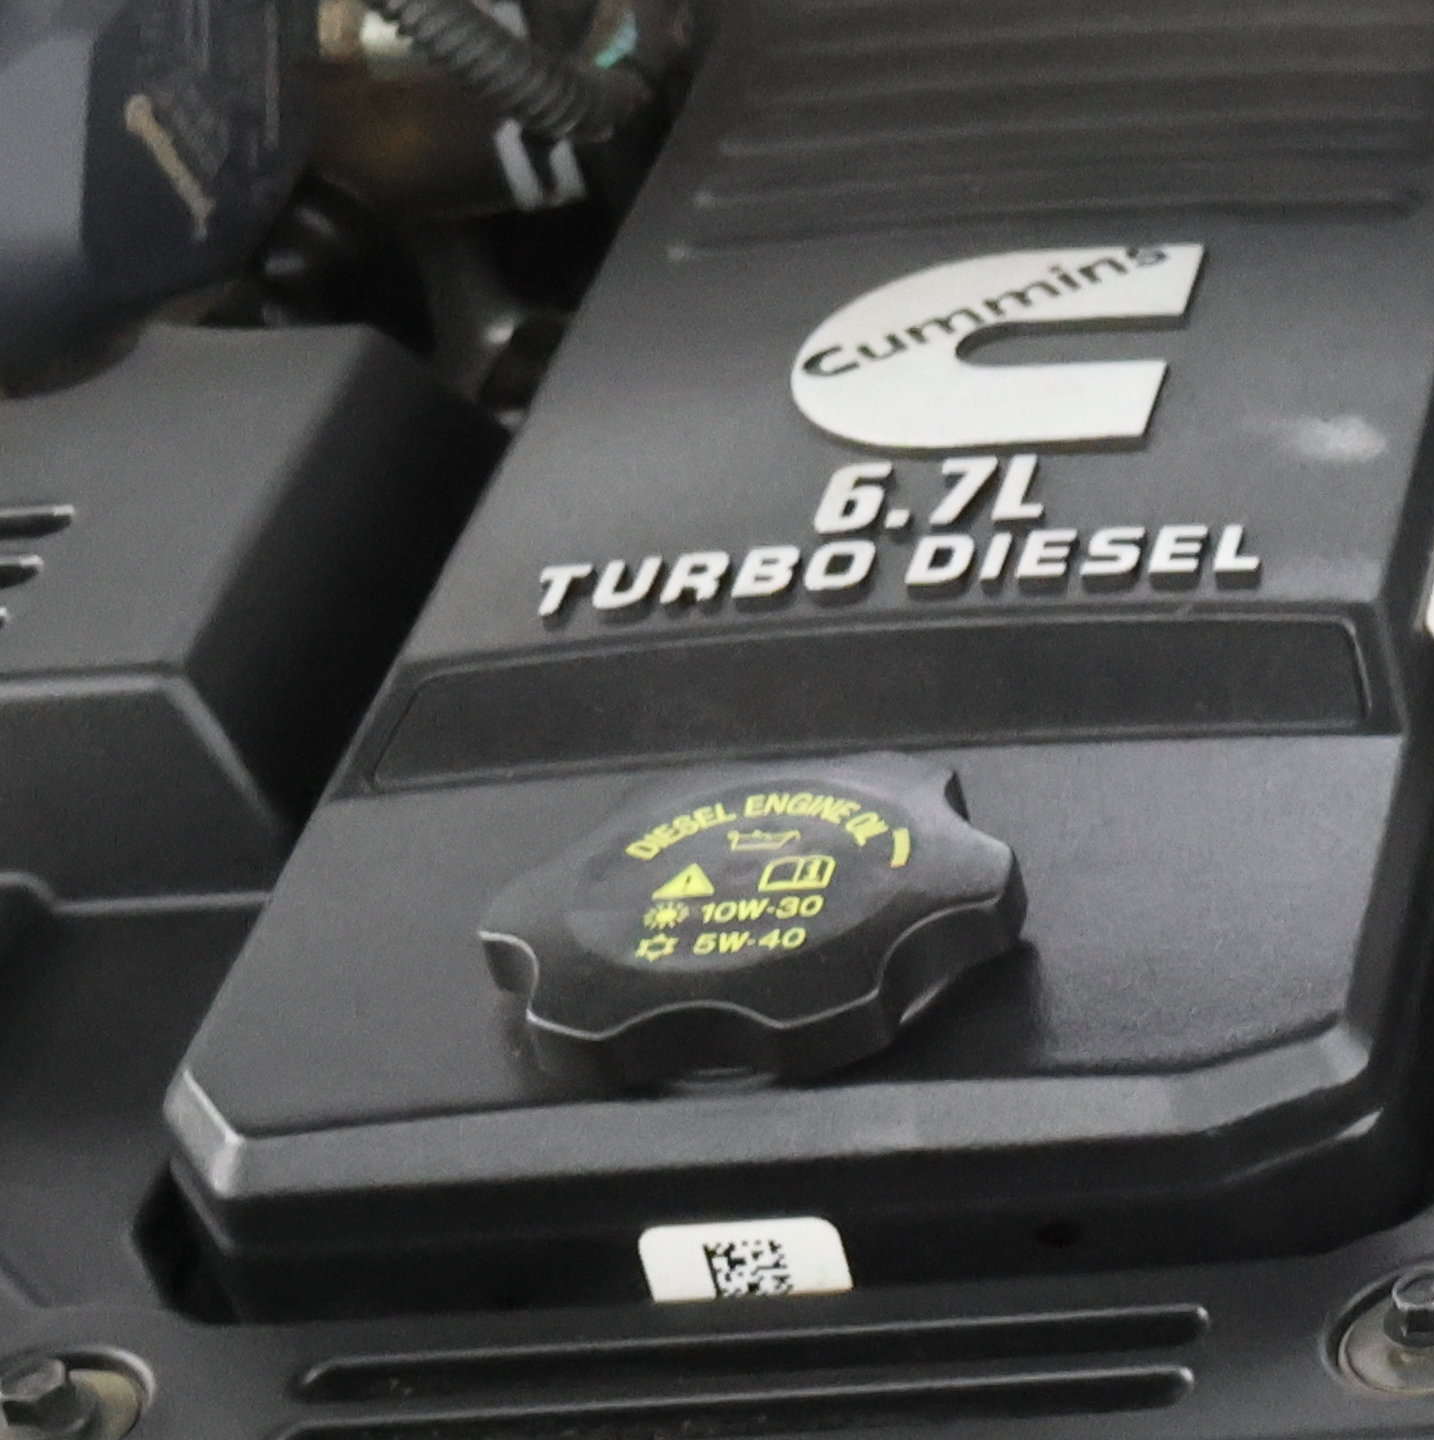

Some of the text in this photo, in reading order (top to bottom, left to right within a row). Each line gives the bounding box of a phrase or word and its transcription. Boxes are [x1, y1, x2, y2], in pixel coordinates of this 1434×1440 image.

[803, 244, 1168, 377] Cummins
[813, 454, 1045, 534] 6.7L
[538, 525, 1260, 616] TURBO DIESEL
[625, 803, 738, 860] DIESEL
[744, 792, 862, 824] ENGINE
[692, 927, 807, 956] 5W-40
[701, 895, 824, 924] 10W-30
